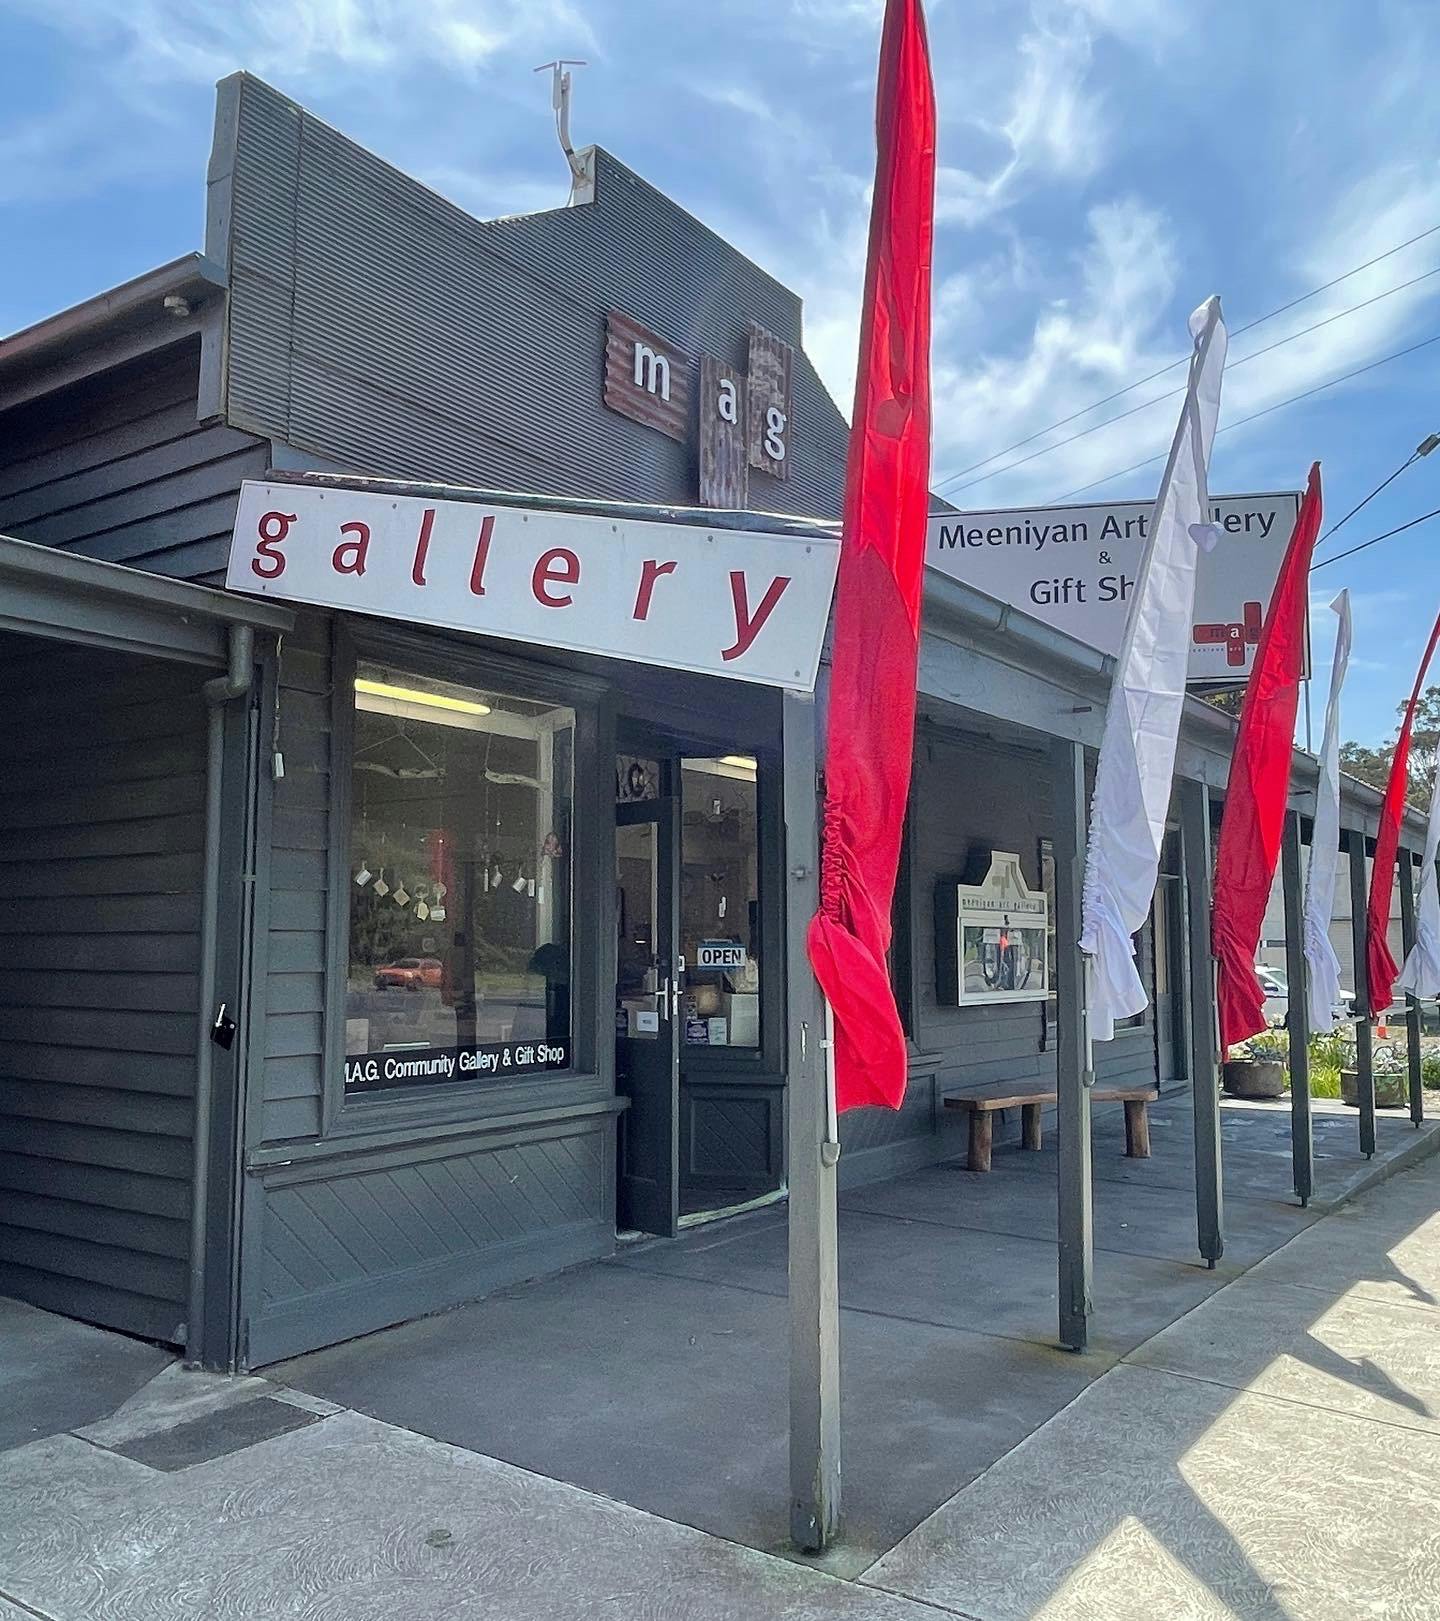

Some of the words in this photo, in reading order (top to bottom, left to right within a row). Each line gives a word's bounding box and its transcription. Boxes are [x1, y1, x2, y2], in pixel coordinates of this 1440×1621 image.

[939, 519, 1088, 551] Meeniyan
[1099, 514, 1149, 540] Art
[1208, 507, 1277, 538] lery
[1098, 550, 1113, 564] &
[251, 509, 792, 662] gallery
[1030, 577, 1087, 605] Gift
[1098, 574, 1135, 602] Sh
[702, 949, 741, 964] OPEN
[384, 1053, 455, 1079] Community
[458, 1050, 499, 1072] Gallery
[502, 1048, 512, 1066] &
[515, 1046, 534, 1065] Gift
[537, 1044, 564, 1064] Shop
